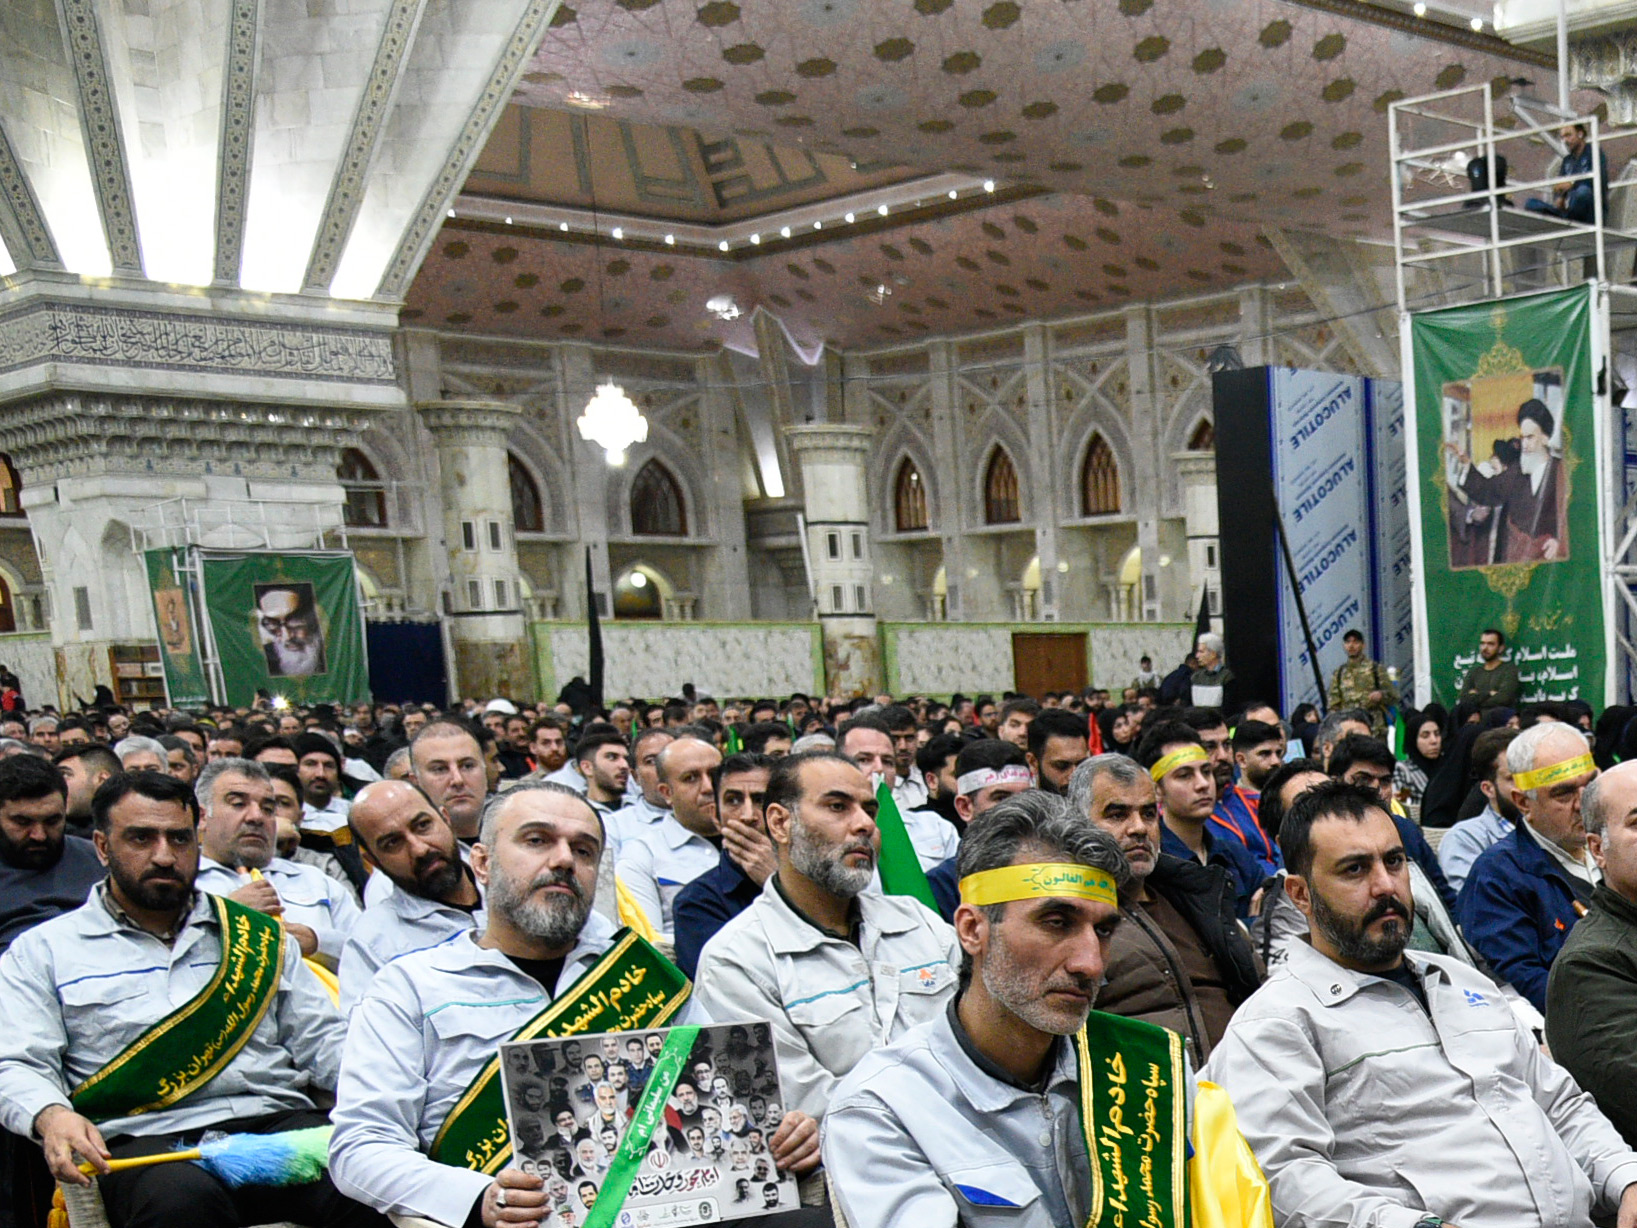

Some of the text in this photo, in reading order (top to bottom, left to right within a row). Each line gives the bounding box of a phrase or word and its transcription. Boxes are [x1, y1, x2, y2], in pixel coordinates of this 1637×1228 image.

[1290, 386, 1352, 449] ALUCOTILE
[1292, 457, 1354, 523] ALUCOTILE
[1299, 599, 1359, 666] ALUCOTE
[235, 915, 256, 955] خادم
[547, 964, 647, 1038] خادم الشهدا
[1105, 1052, 1134, 1136] خادم
[1141, 1062, 1167, 1098] سپاه
[1137, 1097, 1161, 1152] حضرت
[1139, 1155, 1154, 1197] محمد
